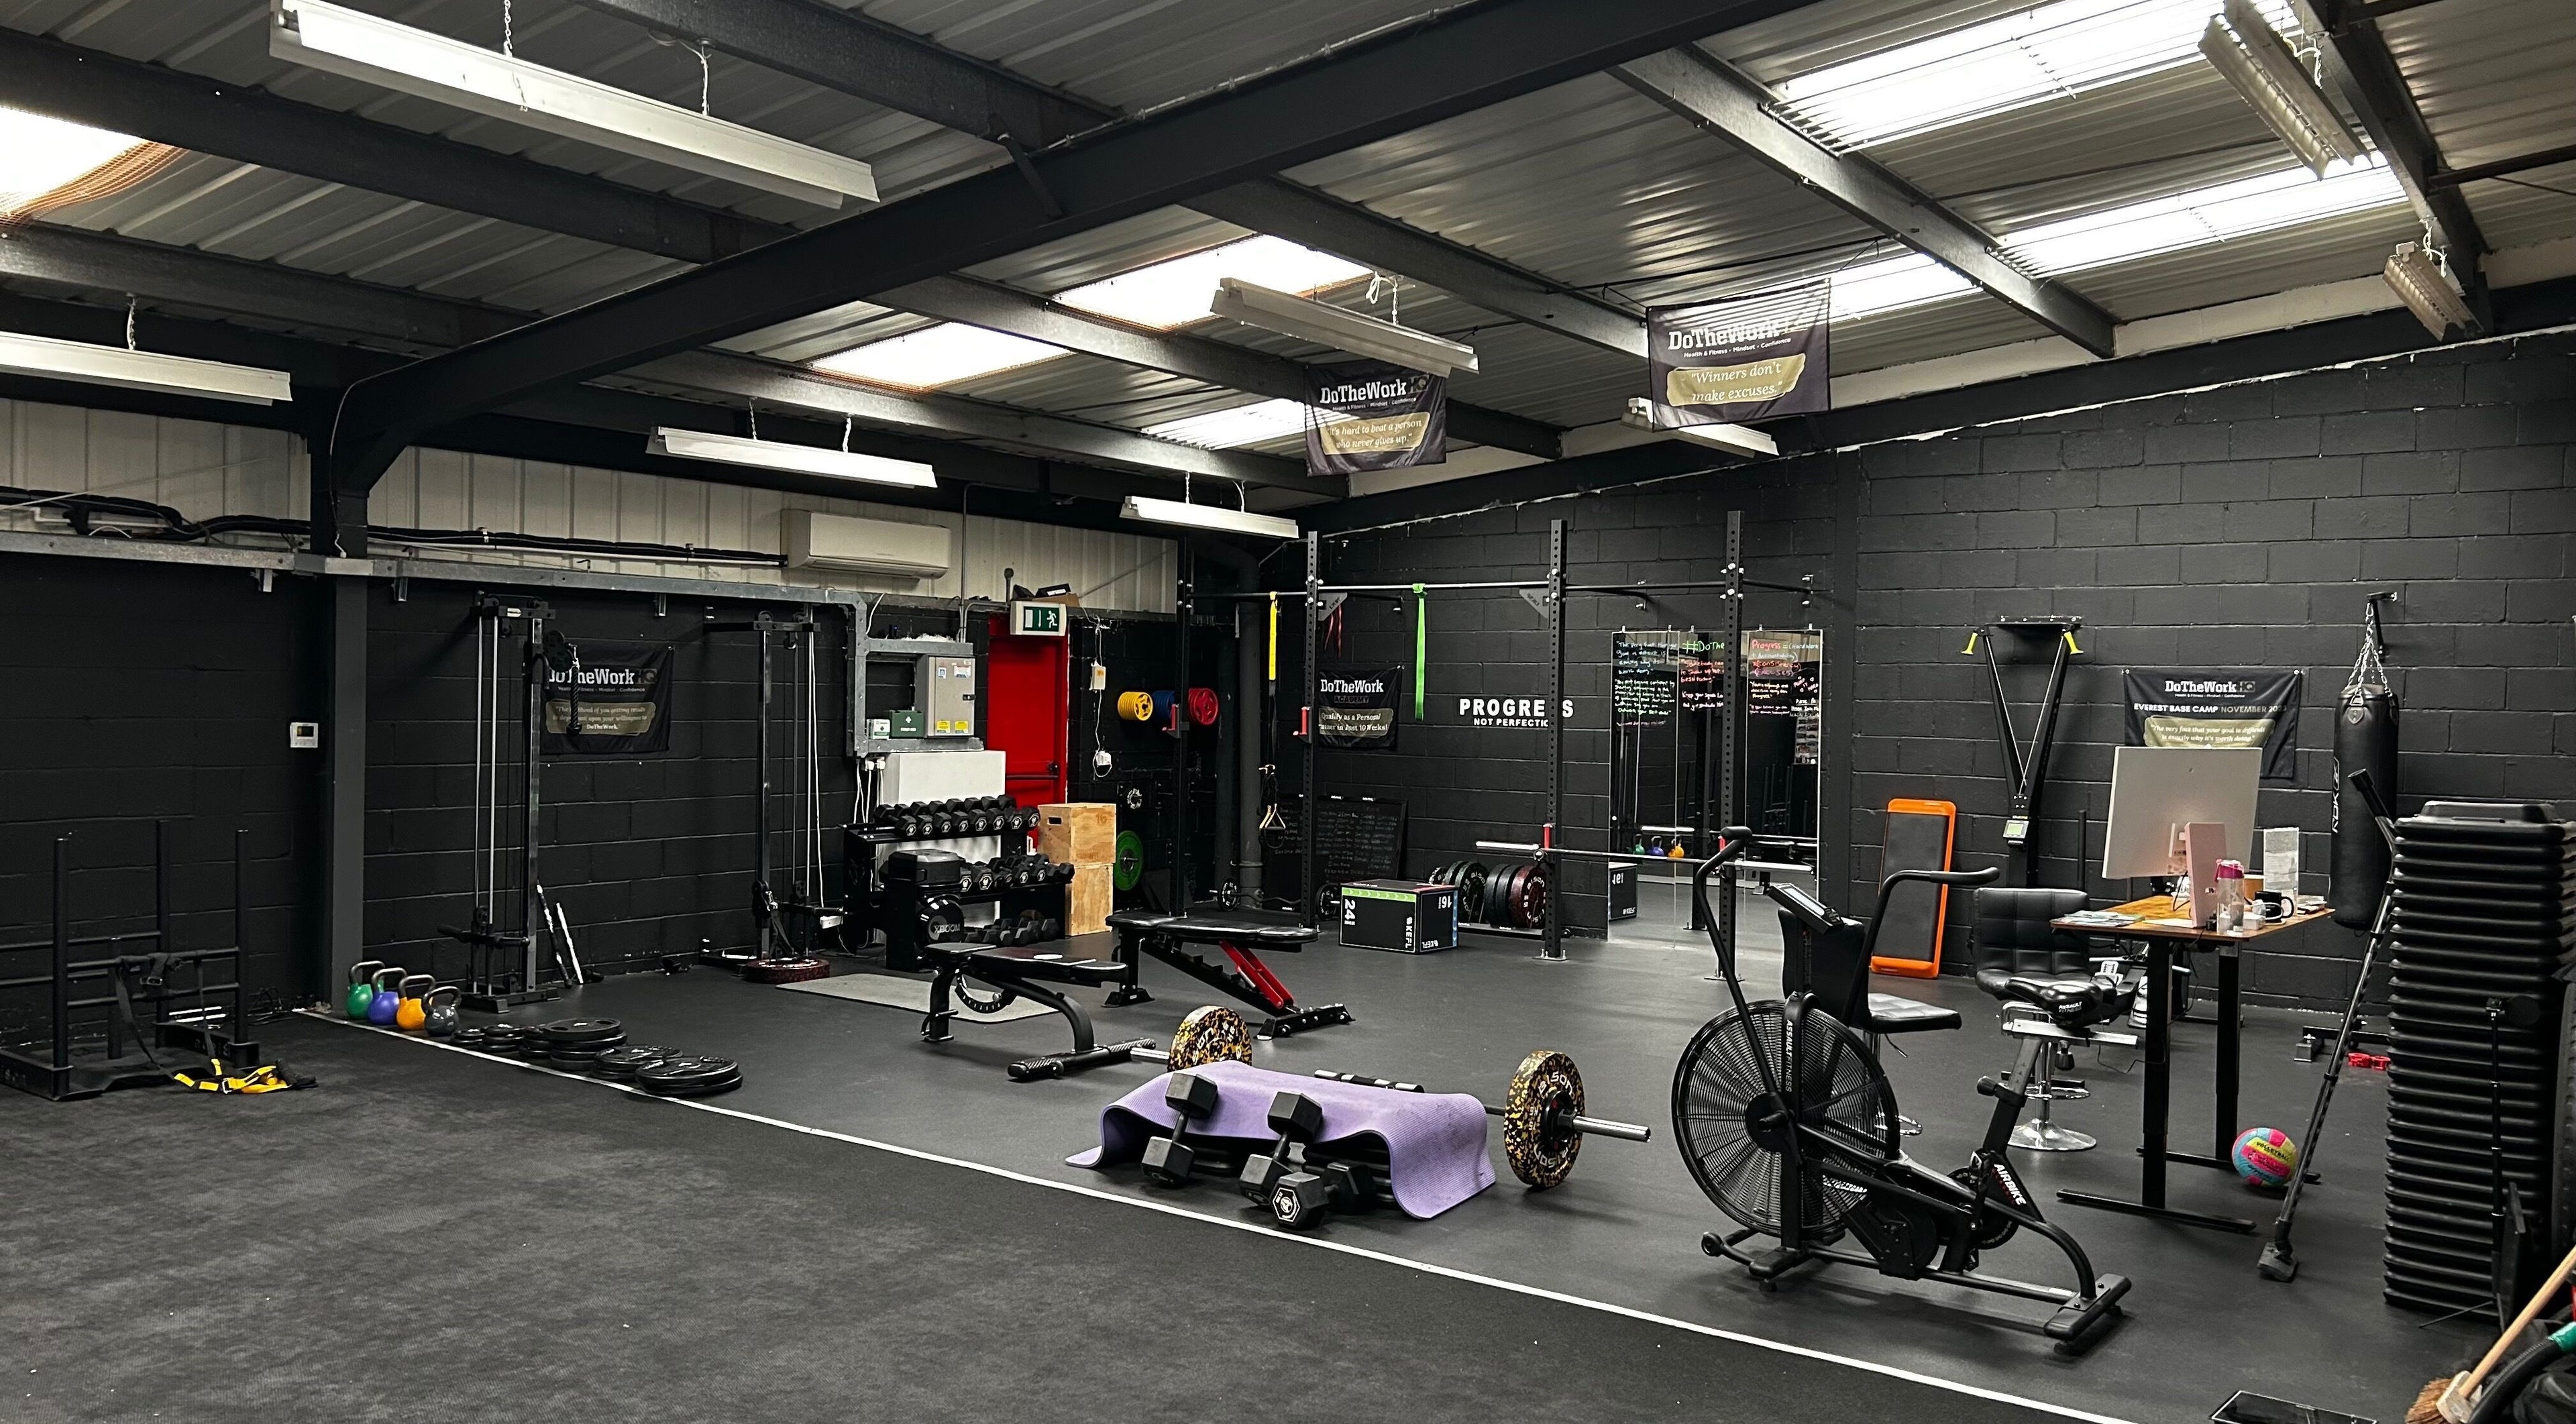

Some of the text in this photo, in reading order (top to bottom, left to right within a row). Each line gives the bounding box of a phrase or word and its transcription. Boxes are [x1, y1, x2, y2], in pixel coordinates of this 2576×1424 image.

[1733, 344, 1755, 352] Mindset
[1760, 337, 1792, 349] Confidence
[1750, 361, 1782, 377] don't
[1320, 378, 1407, 404] DoTheWork
[1692, 389, 1725, 402] make
[1342, 426, 1360, 435] hard
[1362, 426, 1369, 434] to
[1371, 424, 1386, 433] beat
[1395, 419, 1422, 431] person
[1336, 439, 1350, 448] who
[1352, 439, 1373, 448] never
[1375, 436, 1394, 447] gives
[1752, 640, 1781, 651] Progress
[1320, 679, 1384, 693] DoTheWork
[2165, 680, 2237, 693] DoTheWork
[1334, 695, 1369, 704] ACADEMY
[1459, 698, 1574, 718] PROGRES
[2134, 703, 2169, 712] EVEREST
[2169, 705, 2190, 713] BASE
[2192, 705, 2218, 713] CAMP
[1321, 712, 1342, 722] Qualify
[1356, 713, 1381, 721] Personal
[1474, 718, 1549, 727] NOT PERFECTI
[2242, 726, 2265, 734] difficult
[1471, 872, 1486, 884] BISO
[1442, 895, 1452, 908] 16
[1344, 899, 1356, 920] 24
[934, 923, 961, 934] XBOOM
[2058, 1001, 2082, 1009] ASSAULT
[1538, 1071, 1573, 1095] BISON
[1994, 1164, 2027, 1205] AIRBIKE
